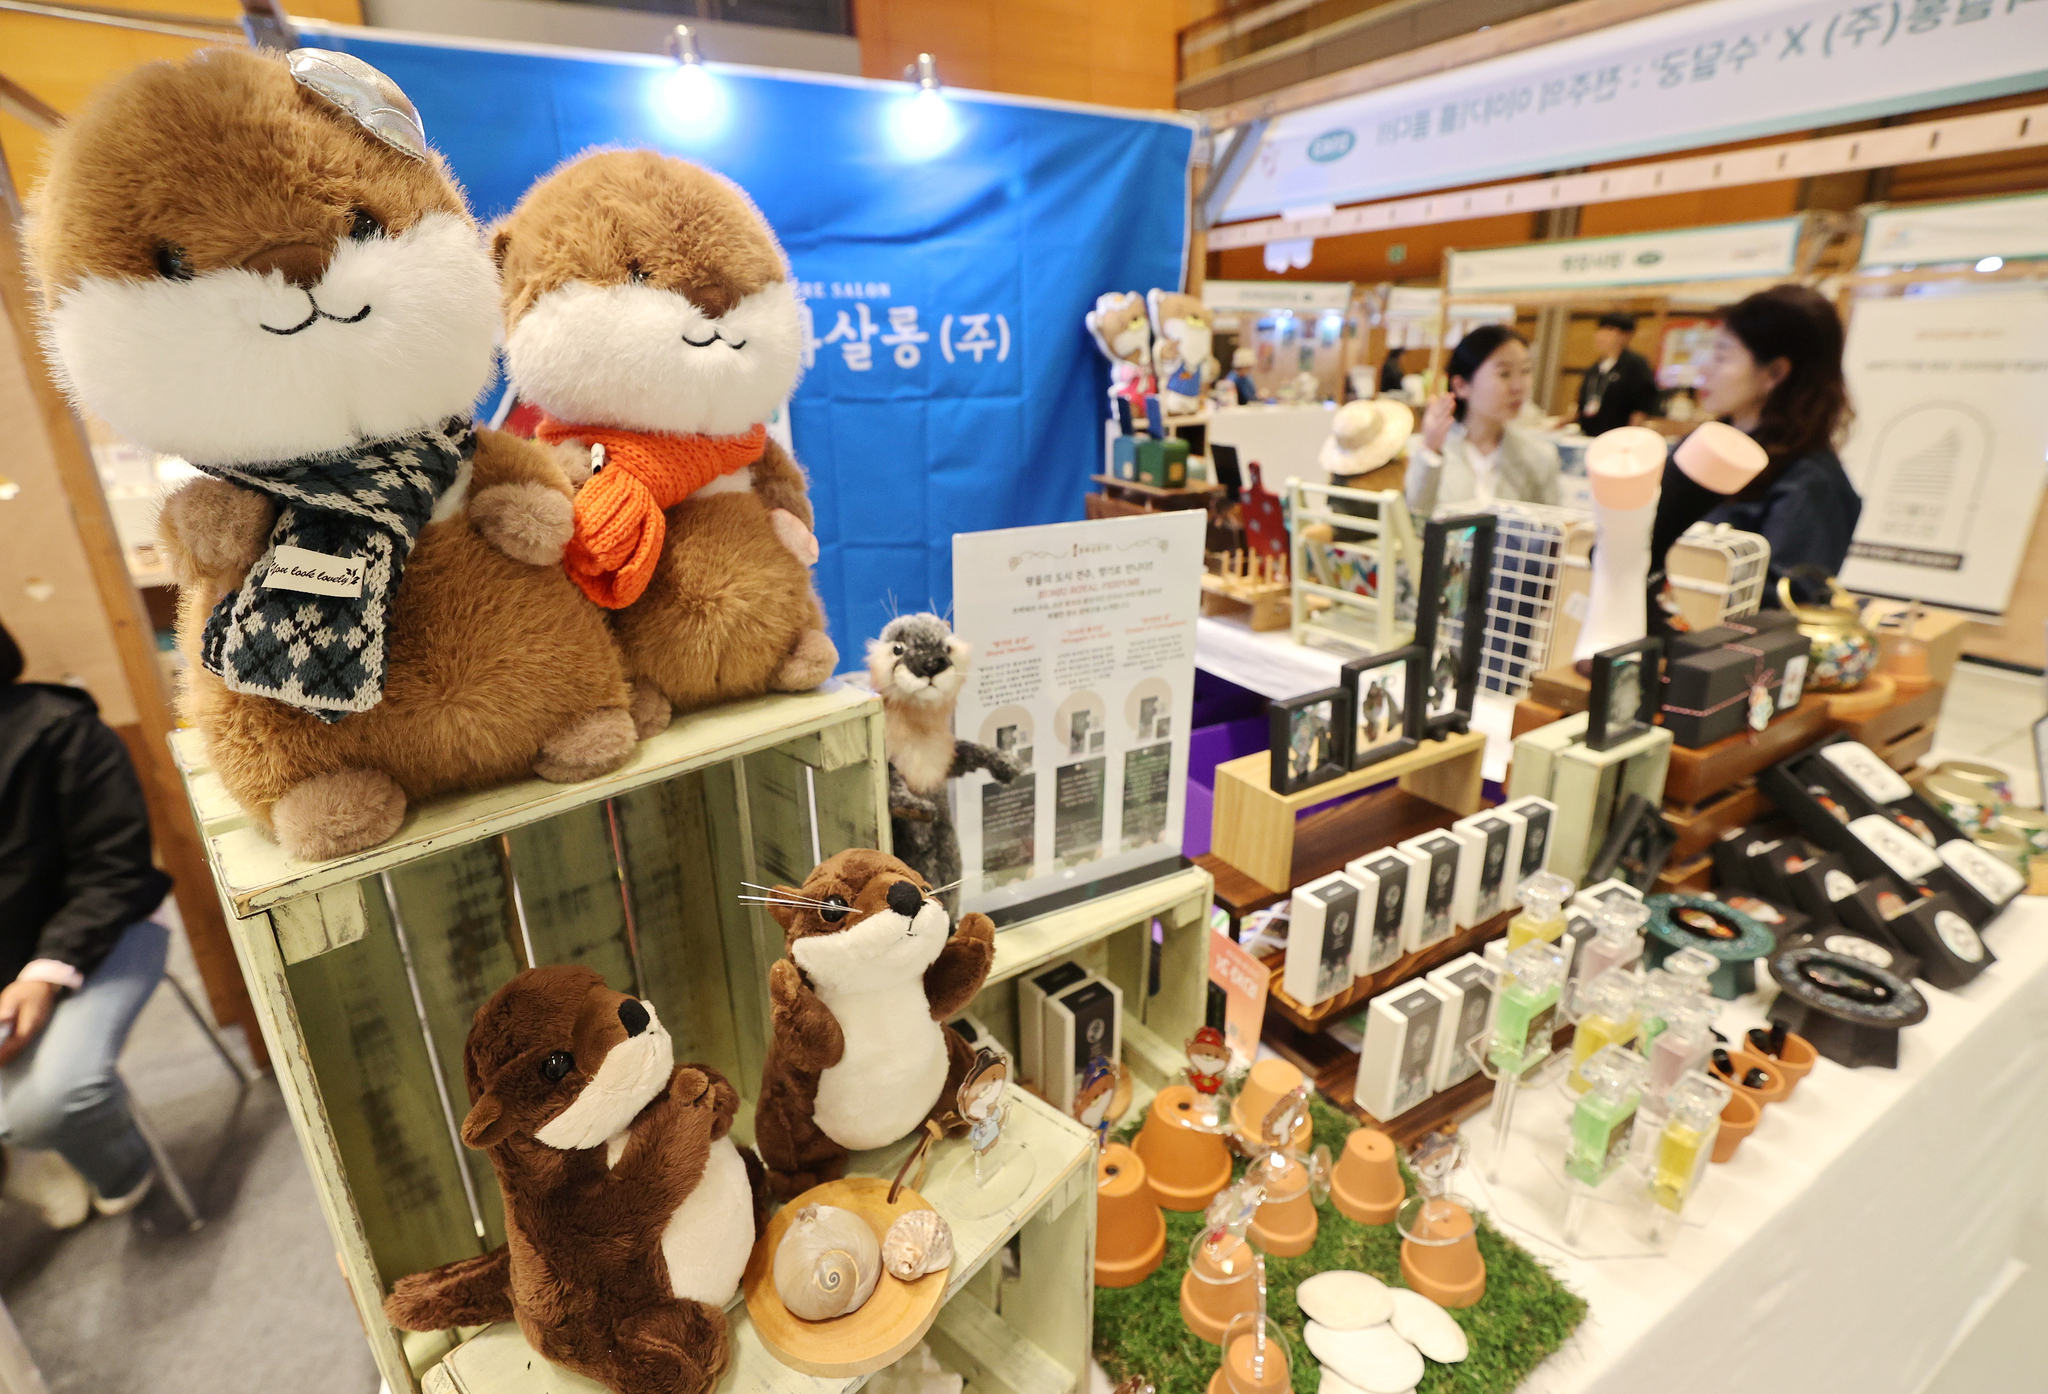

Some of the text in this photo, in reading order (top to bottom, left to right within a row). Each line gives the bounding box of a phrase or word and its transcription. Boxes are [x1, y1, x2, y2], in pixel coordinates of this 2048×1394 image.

[831, 281, 891, 299] SALON
[291, 566, 317, 579] look
[316, 571, 348, 586] lovely
[1055, 571, 1073, 583] 도시
[1070, 583, 1098, 595] ROYAL
[1102, 577, 1141, 589] PERFUME
